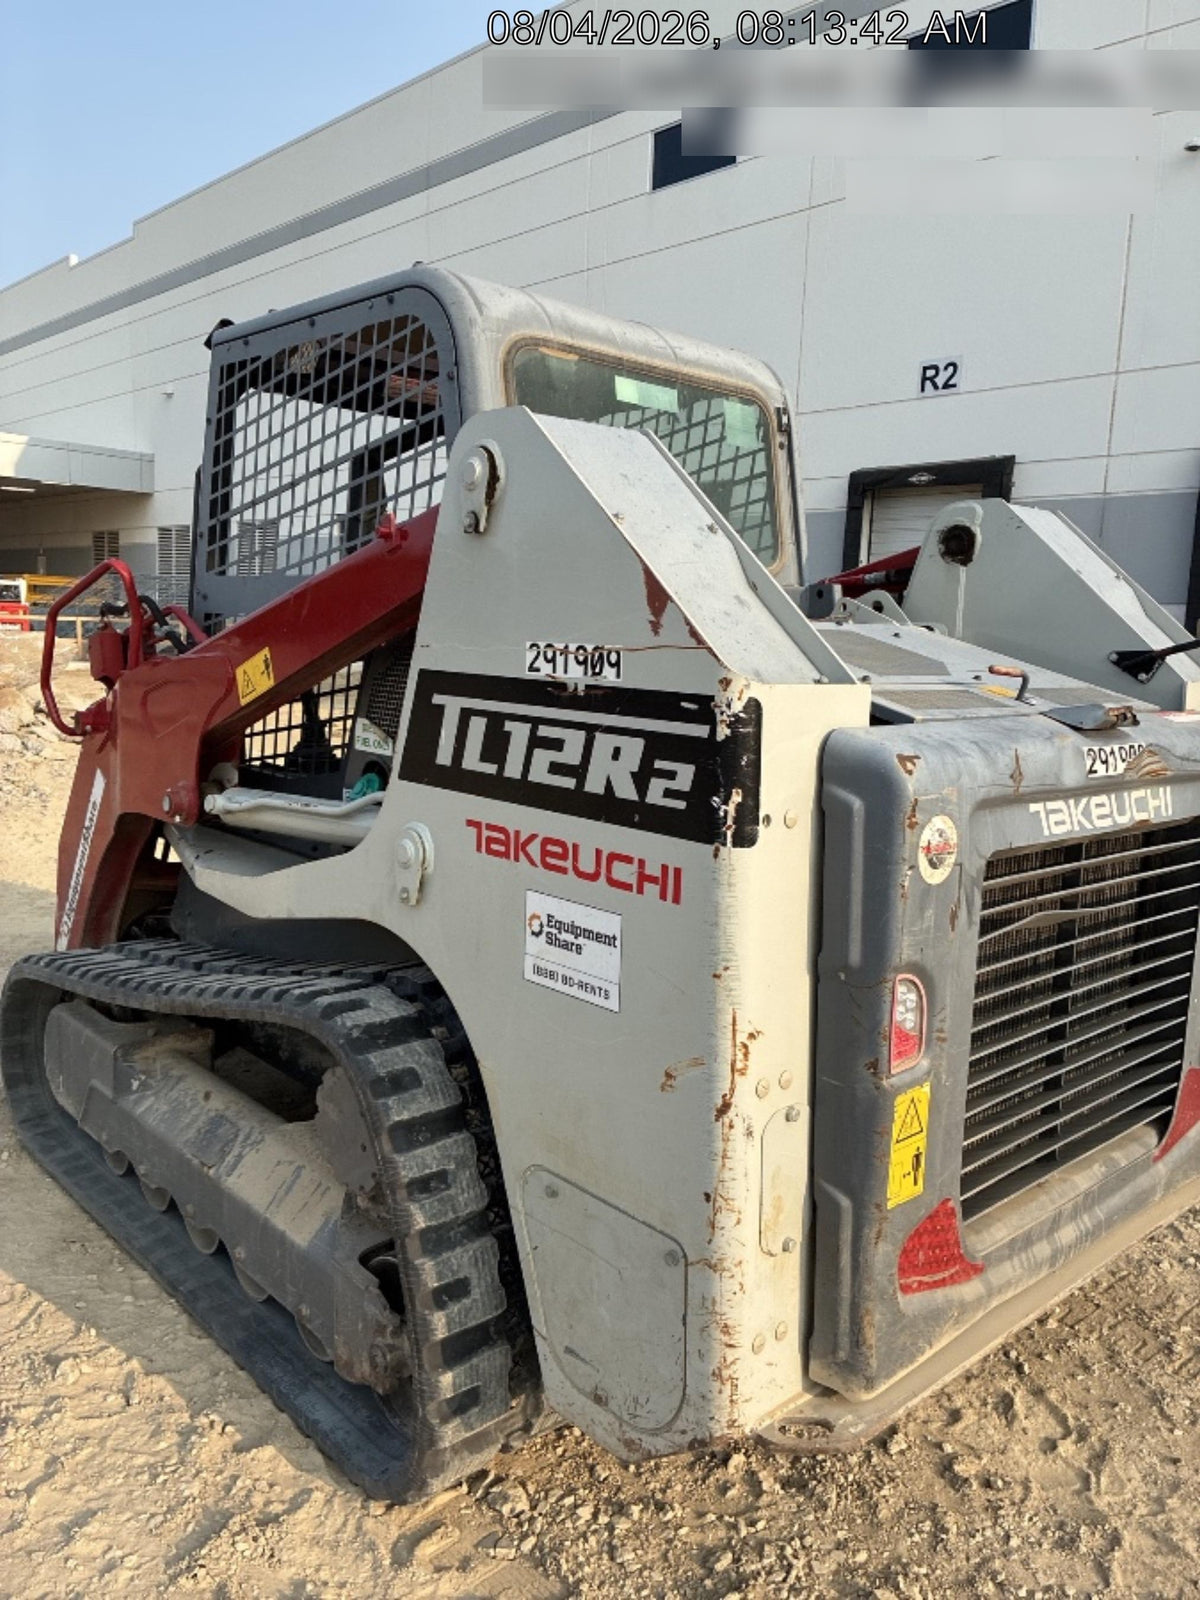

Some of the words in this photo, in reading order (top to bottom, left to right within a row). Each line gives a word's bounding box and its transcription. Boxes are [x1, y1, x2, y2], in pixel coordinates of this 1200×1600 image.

[920, 361, 959, 393] R2
[527, 643, 621, 680] 291909
[545, 931, 583, 956] Share
[546, 913, 618, 949] Equipment
